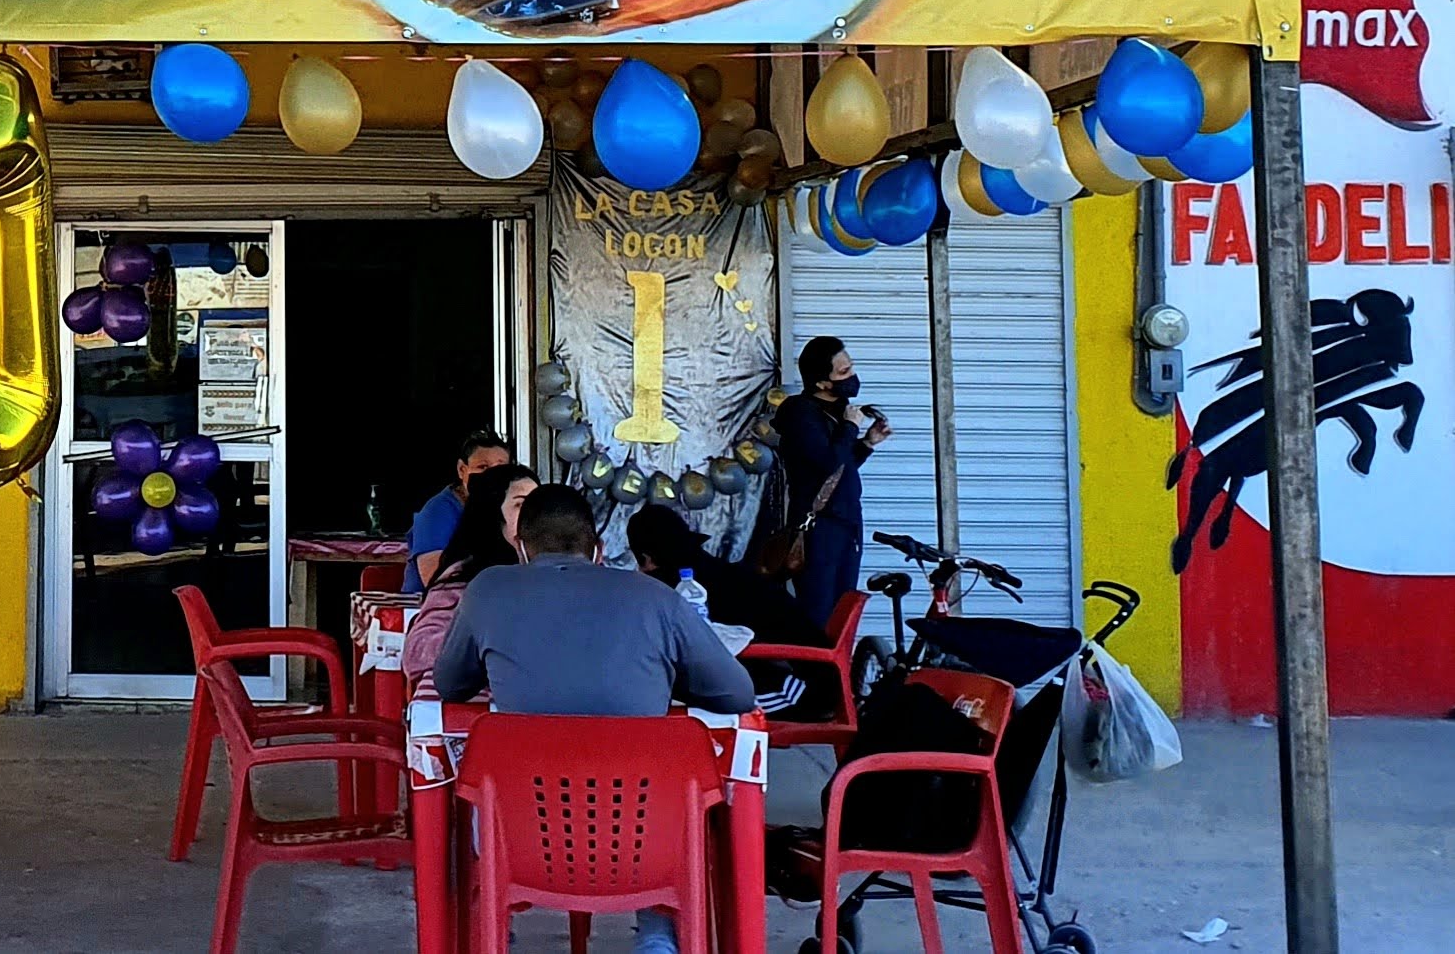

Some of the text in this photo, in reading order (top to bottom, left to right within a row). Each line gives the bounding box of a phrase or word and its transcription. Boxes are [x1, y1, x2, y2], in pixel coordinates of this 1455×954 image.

[1306, 9, 1419, 47] max
[575, 189, 721, 220] LA CASA
[1171, 182, 1451, 265] FADELI
